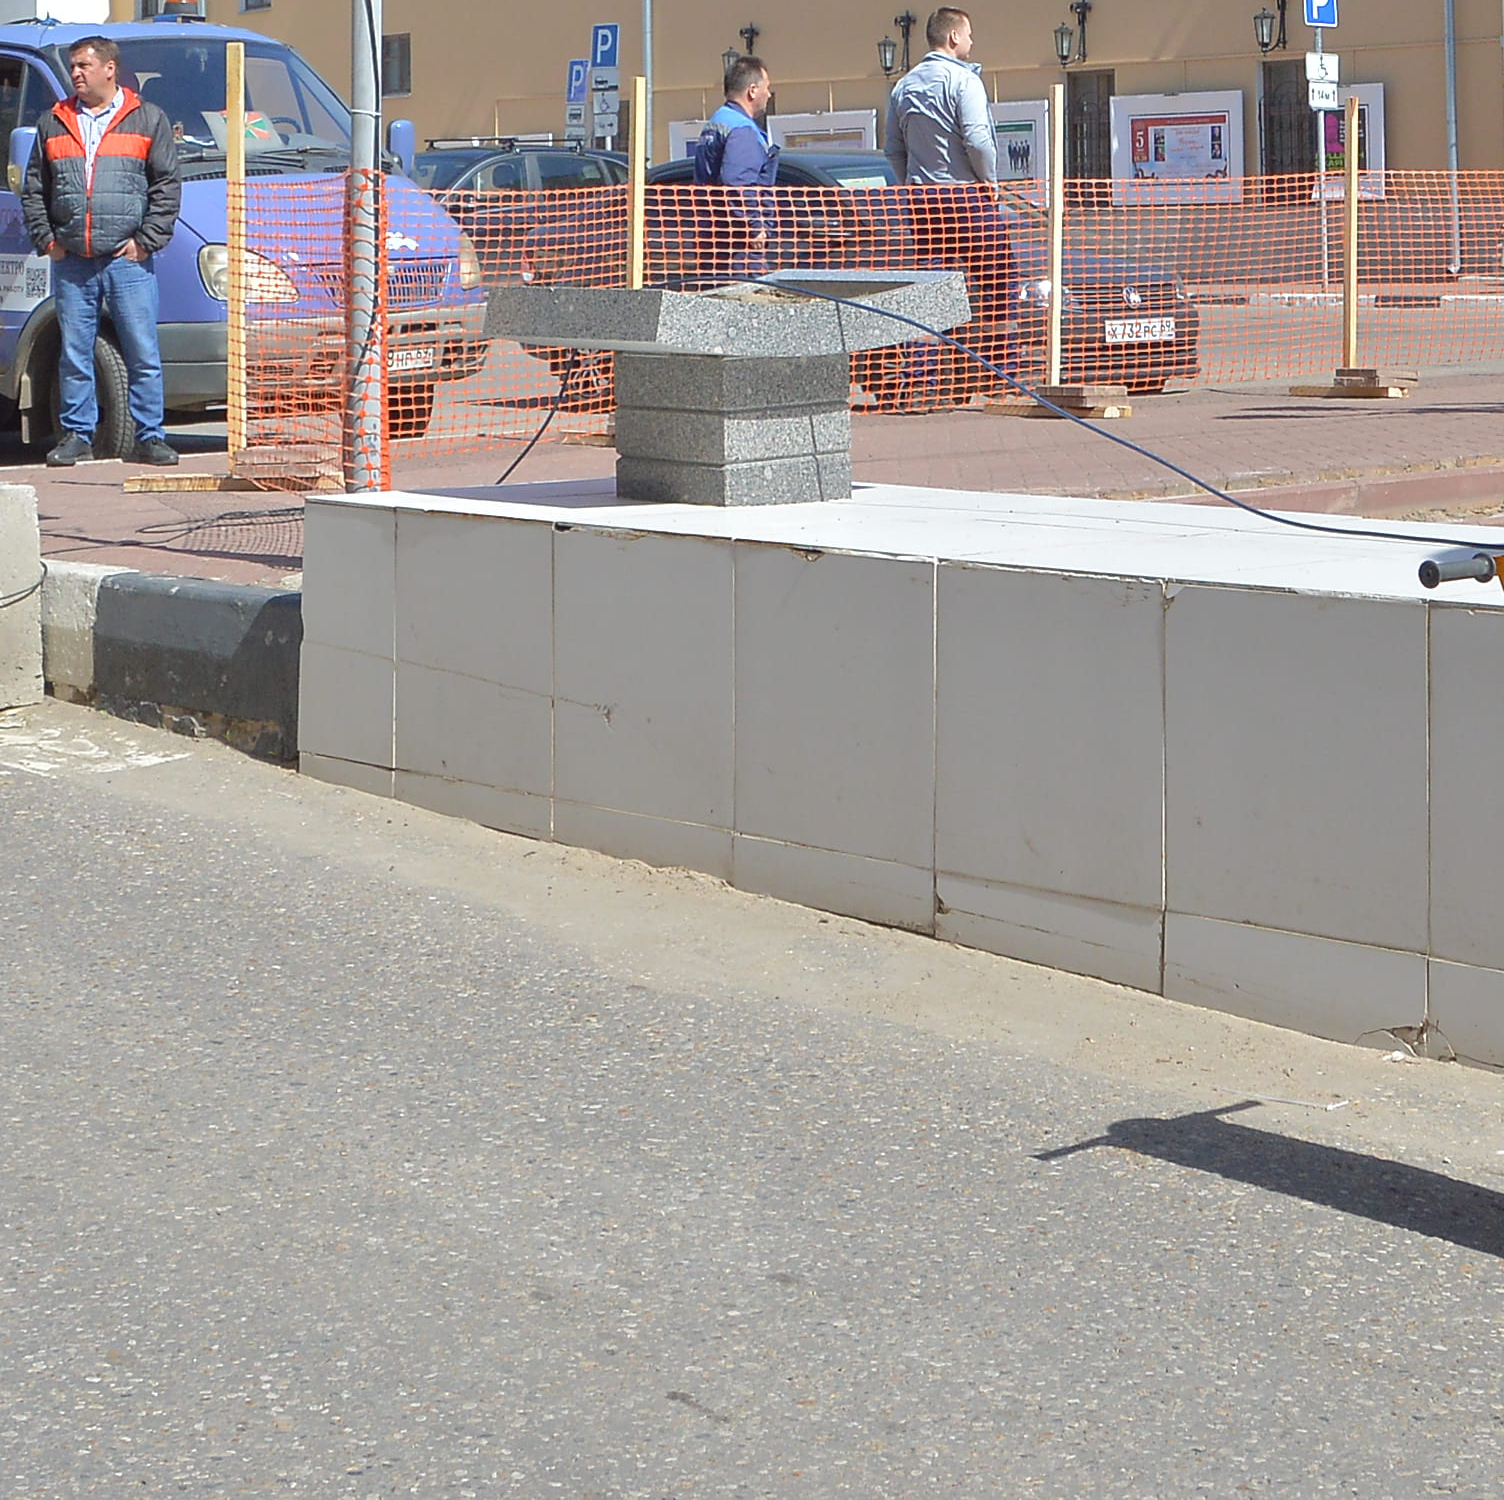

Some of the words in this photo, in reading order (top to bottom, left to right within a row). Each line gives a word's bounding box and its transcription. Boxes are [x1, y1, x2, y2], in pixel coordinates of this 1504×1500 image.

[596, 28, 612, 64] P
[571, 64, 584, 99] P
[1135, 131, 1145, 149] 5
